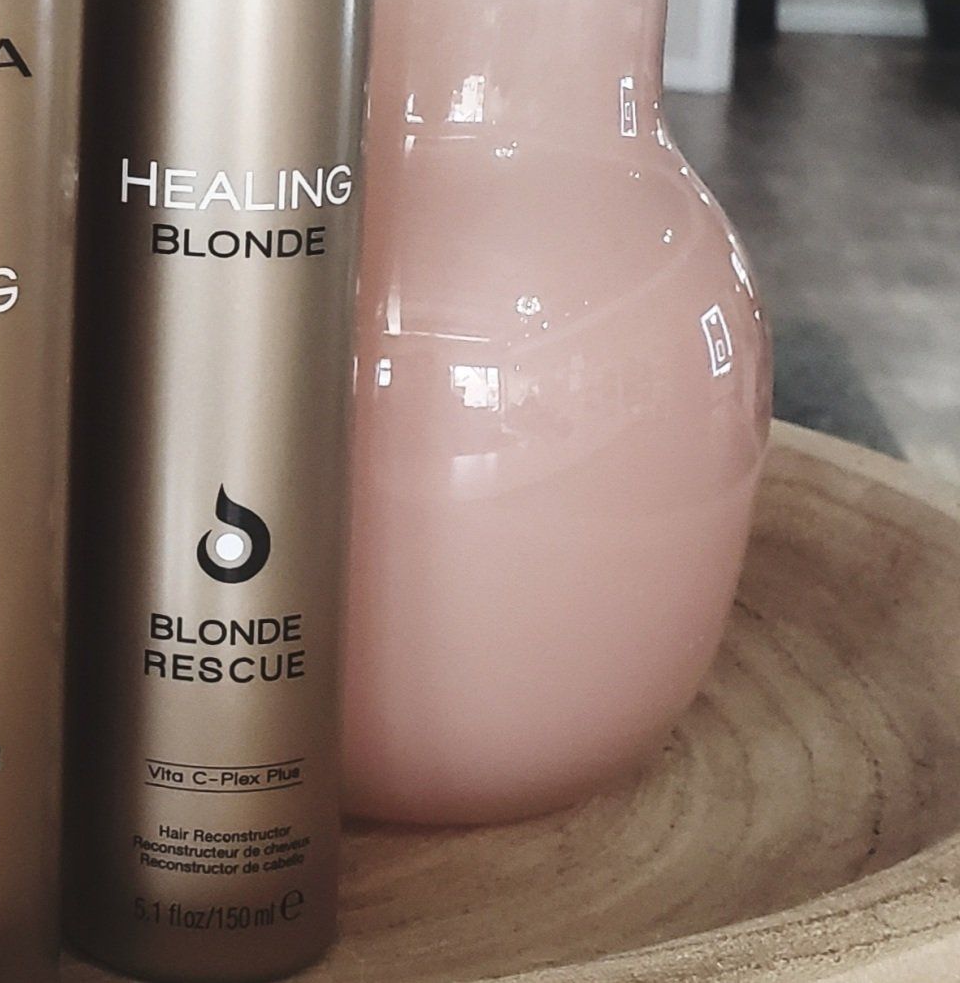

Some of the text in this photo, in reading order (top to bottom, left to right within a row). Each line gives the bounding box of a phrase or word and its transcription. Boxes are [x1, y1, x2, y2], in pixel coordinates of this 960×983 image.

[121, 158, 353, 212] HEALING
[151, 223, 327, 259] BLONDE
[149, 612, 303, 646] BLONDE
[144, 649, 306, 684] RESCUE
[148, 764, 301, 787] Vita C-Plex Plus
[133, 835, 239, 859] Reconstructeur
[243, 845, 260, 858] de
[158, 824, 292, 844] Hair Reconstructor
[140, 853, 239, 875] Reconstructor
[242, 861, 260, 873] de
